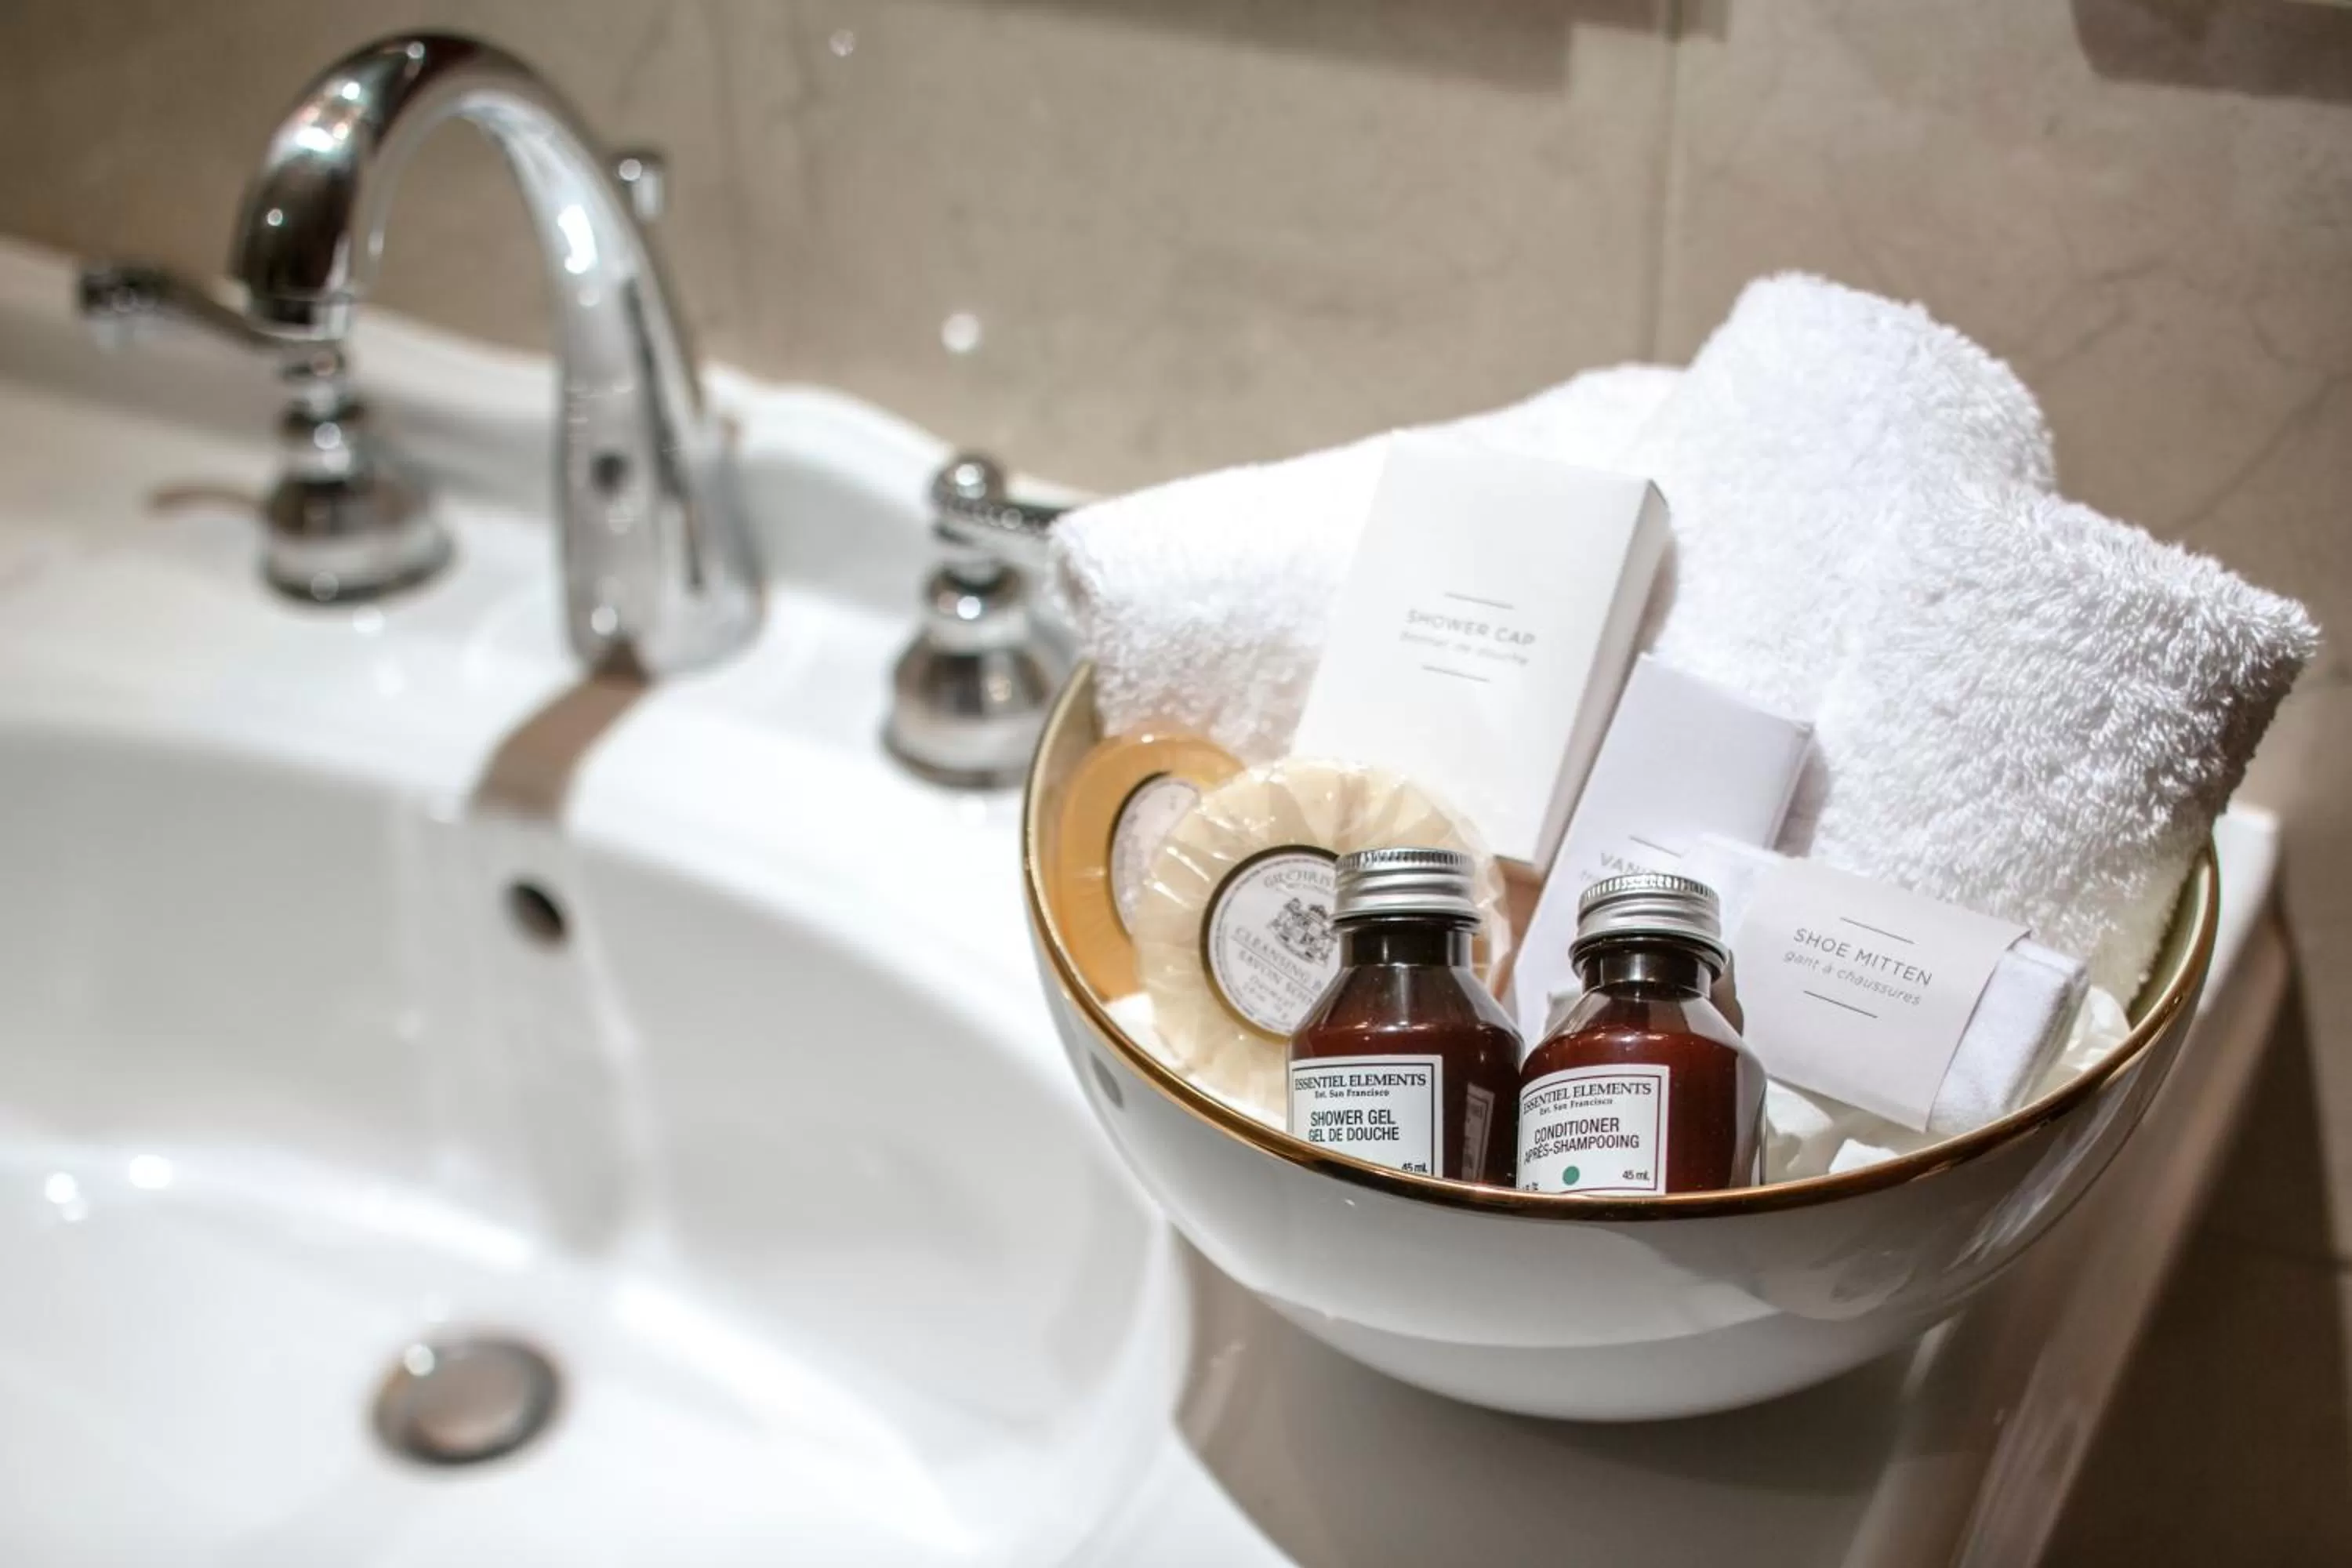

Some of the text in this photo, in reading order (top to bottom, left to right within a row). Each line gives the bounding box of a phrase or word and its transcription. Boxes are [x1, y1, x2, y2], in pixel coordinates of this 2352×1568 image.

[1404, 608, 1537, 646] SHOWER CAP
[1793, 927, 1933, 986] SHOE MITTEN
[1782, 949, 1820, 970] gant
[1837, 968, 1922, 1007] chaussures
[1294, 1073, 1427, 1091] ESSENTIEL ELEMENTS
[1329, 1089, 1345, 1098] San
[1346, 1088, 1390, 1098] Francisco
[1523, 1083, 1652, 1115] ESSENTIEL ELEMENTS
[1553, 1102, 1567, 1112] San
[1570, 1098, 1613, 1108] Francisco
[1310, 1109, 1396, 1127] SHOWER GEL
[1308, 1127, 1399, 1142] GEL DE DOUCHE
[1534, 1117, 1620, 1145] CONDITIONER
[1622, 1169, 1635, 1181] 45
